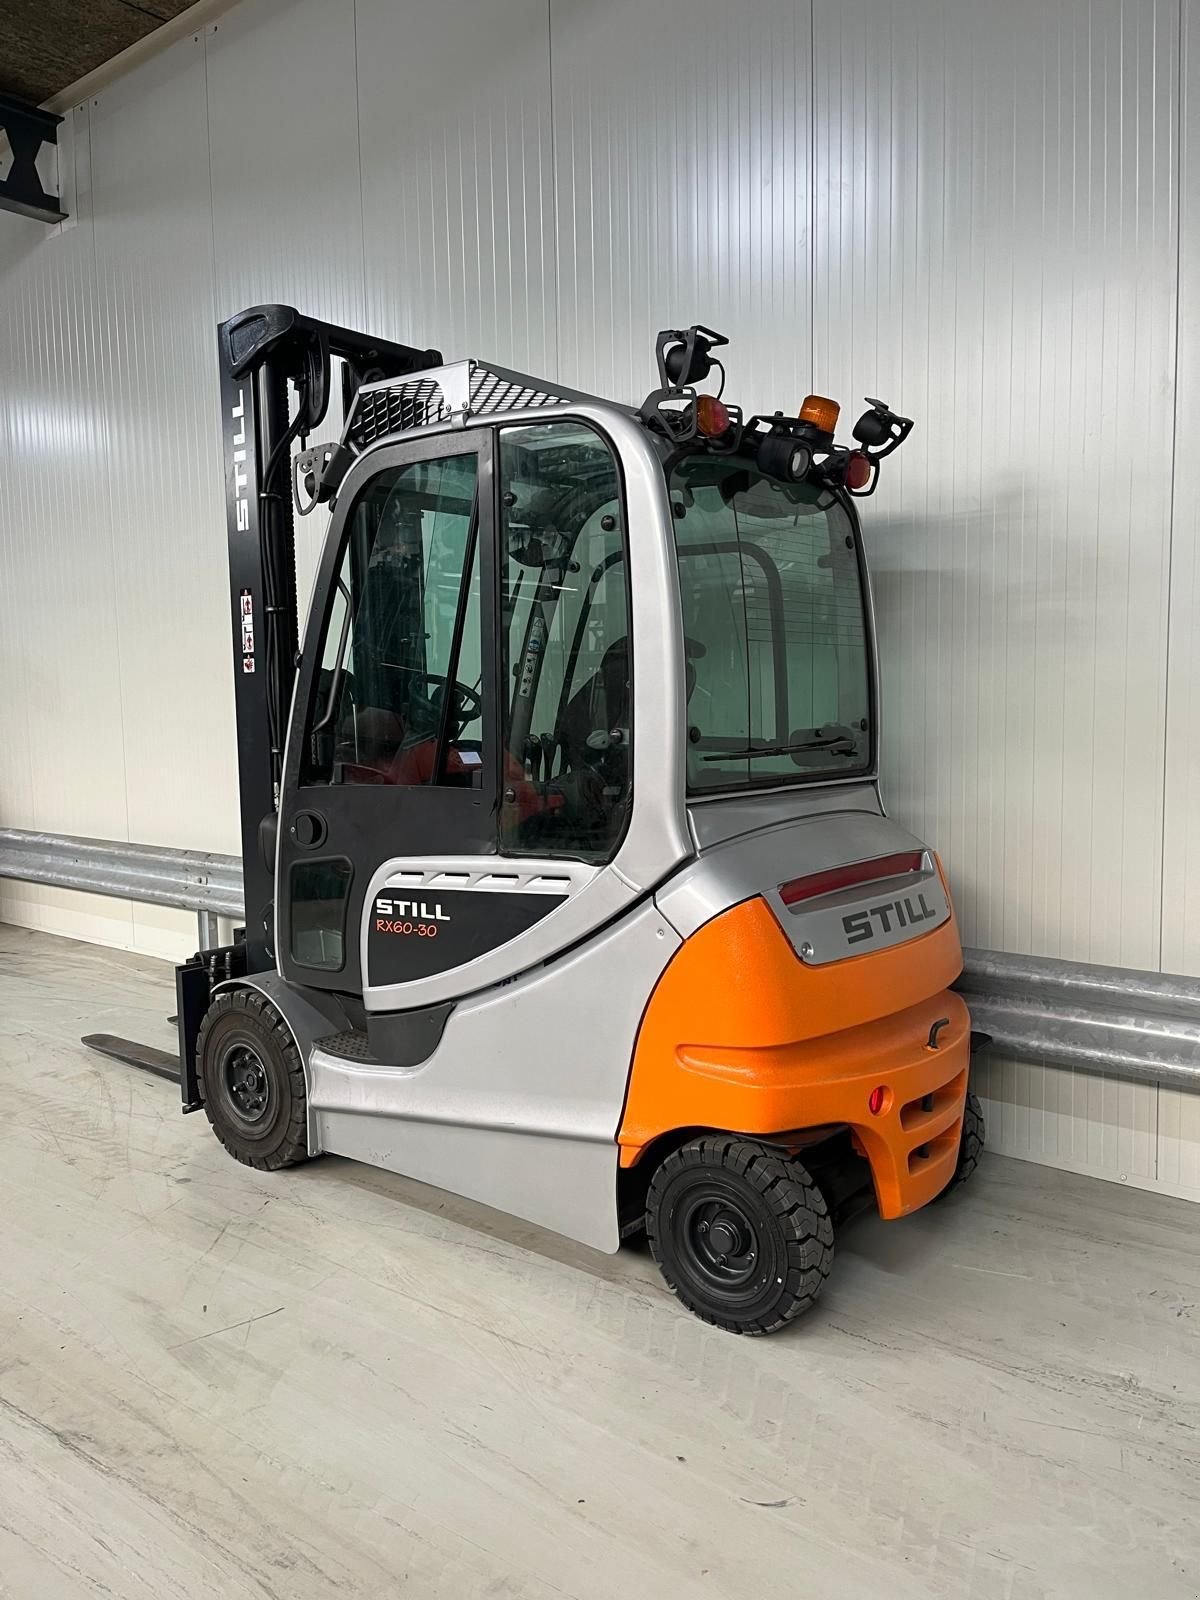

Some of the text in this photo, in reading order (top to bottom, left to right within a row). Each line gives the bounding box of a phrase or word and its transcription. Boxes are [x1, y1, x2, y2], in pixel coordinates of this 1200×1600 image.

[231, 389, 250, 532] STILL
[376, 898, 451, 921] STILL
[376, 919, 437, 937] RX60-30
[842, 893, 937, 945] STILL
